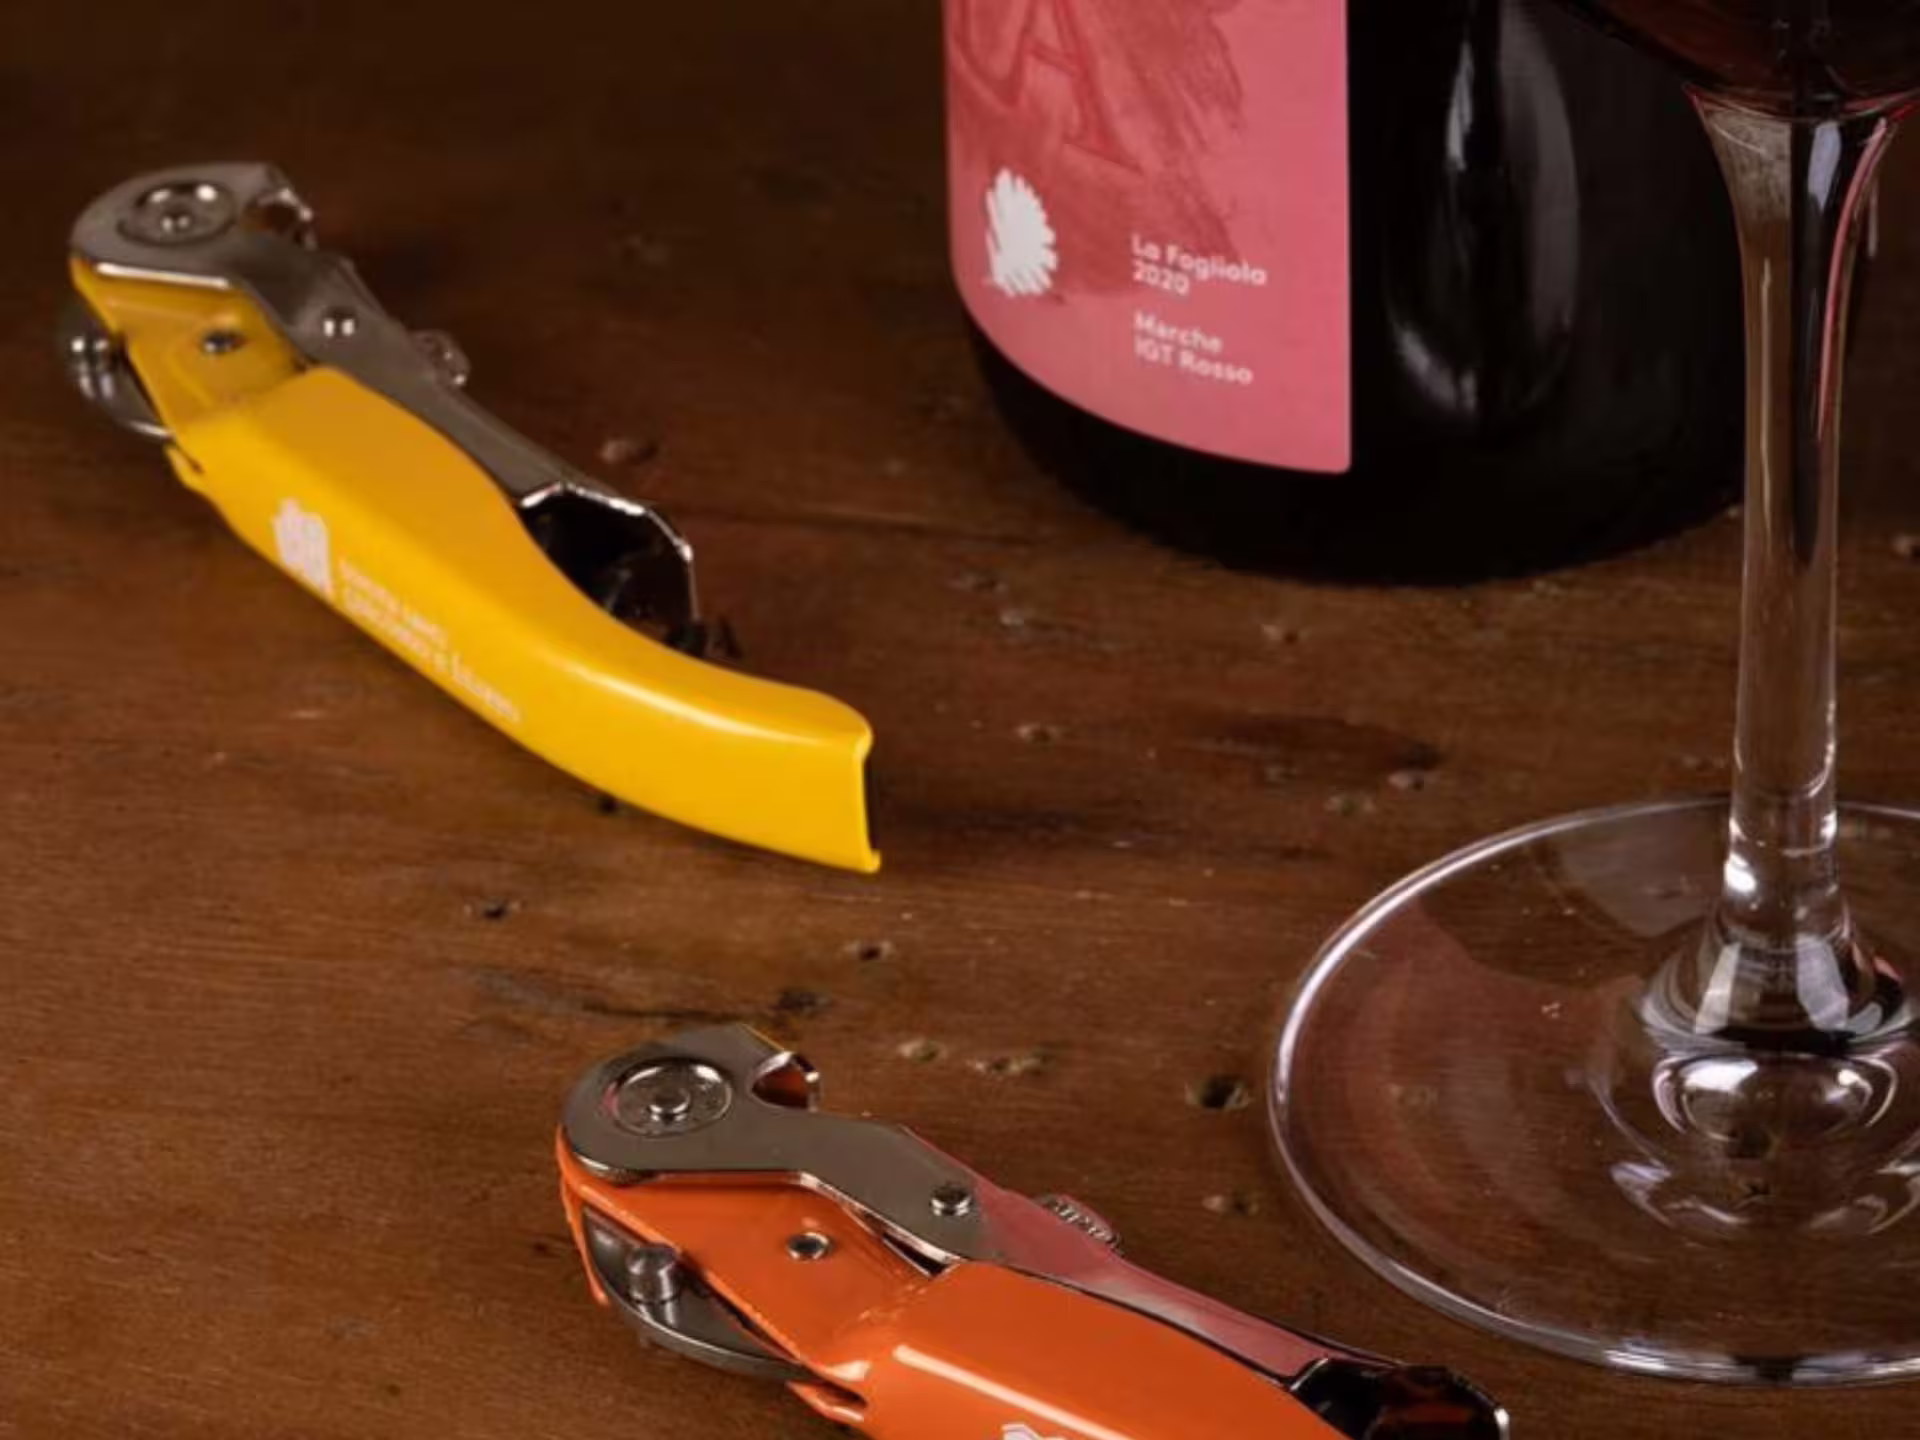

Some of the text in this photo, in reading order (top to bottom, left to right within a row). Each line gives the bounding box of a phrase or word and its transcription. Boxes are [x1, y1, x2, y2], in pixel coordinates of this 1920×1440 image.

[1131, 234, 1161, 261] La
[1133, 259, 1190, 295] 2020
[1134, 312, 1222, 353] Marche
[1135, 337, 1253, 385] IGT Rosso
